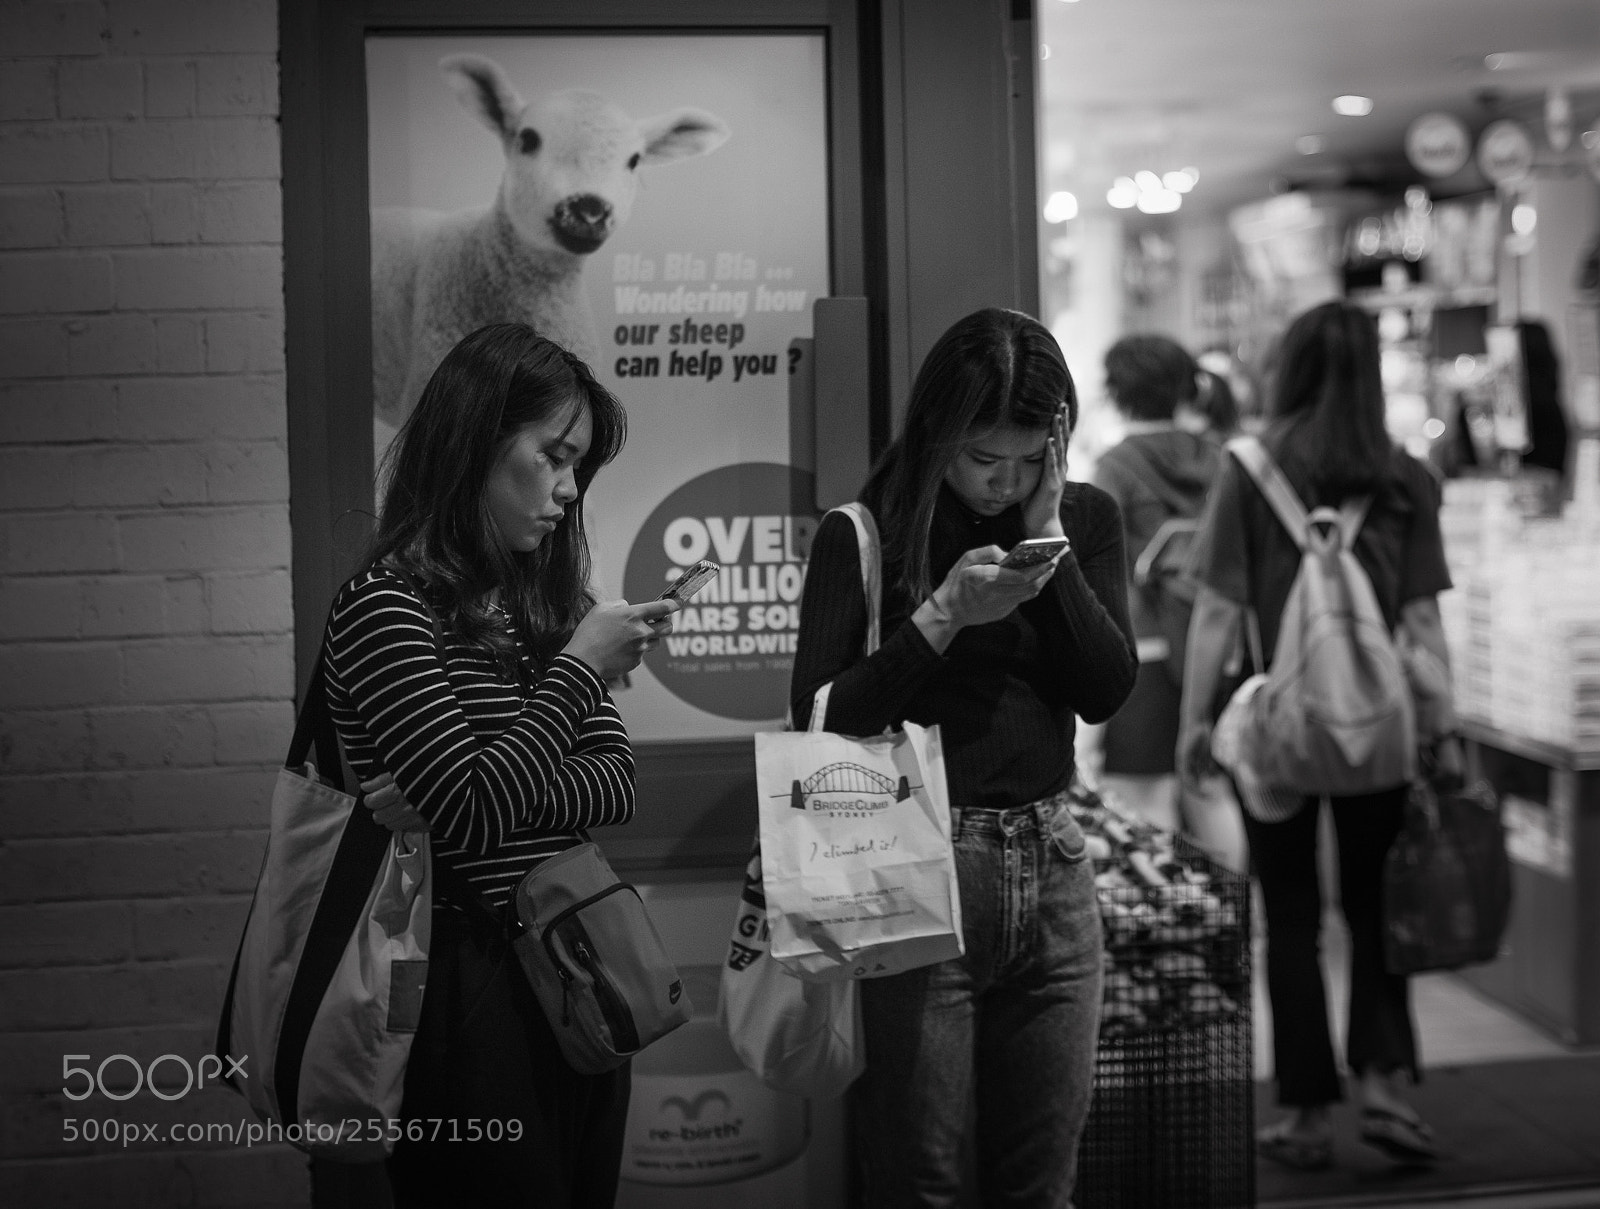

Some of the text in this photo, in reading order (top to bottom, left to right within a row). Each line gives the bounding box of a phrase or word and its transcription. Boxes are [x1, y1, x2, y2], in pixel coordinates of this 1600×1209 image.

[614, 253, 655, 282] Bla
[664, 253, 706, 281] Bla
[715, 252, 756, 280] Bla
[614, 283, 807, 319] Wondering how
[614, 316, 745, 350] our sheep
[614, 347, 803, 383] can help you ?
[689, 563, 808, 604] MILLIO
[747, 604, 800, 631] SOL
[666, 633, 799, 657] WORLDWI
